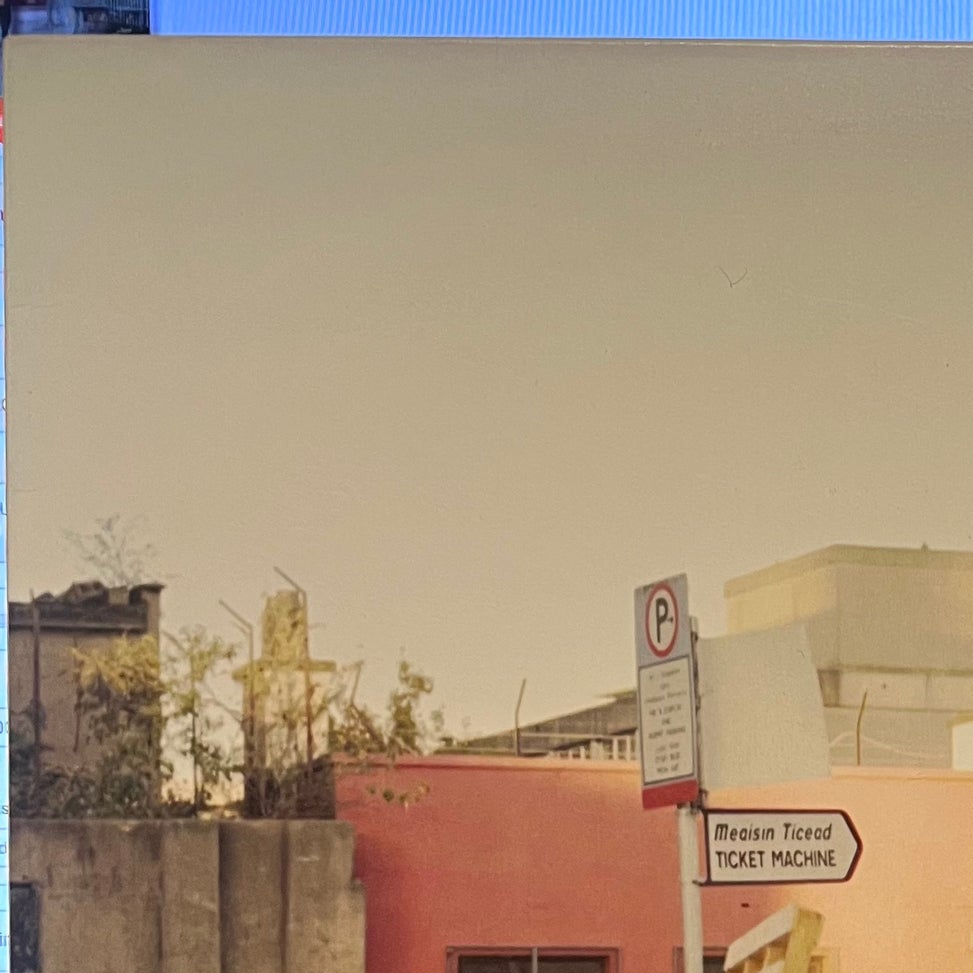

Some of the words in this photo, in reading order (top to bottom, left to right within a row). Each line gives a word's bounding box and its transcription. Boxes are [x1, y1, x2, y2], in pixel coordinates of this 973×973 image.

[655, 597, 669, 644] P
[783, 822, 833, 841] Ticead
[715, 850, 766, 869] TICKET
[771, 849, 837, 868] MACHINE
